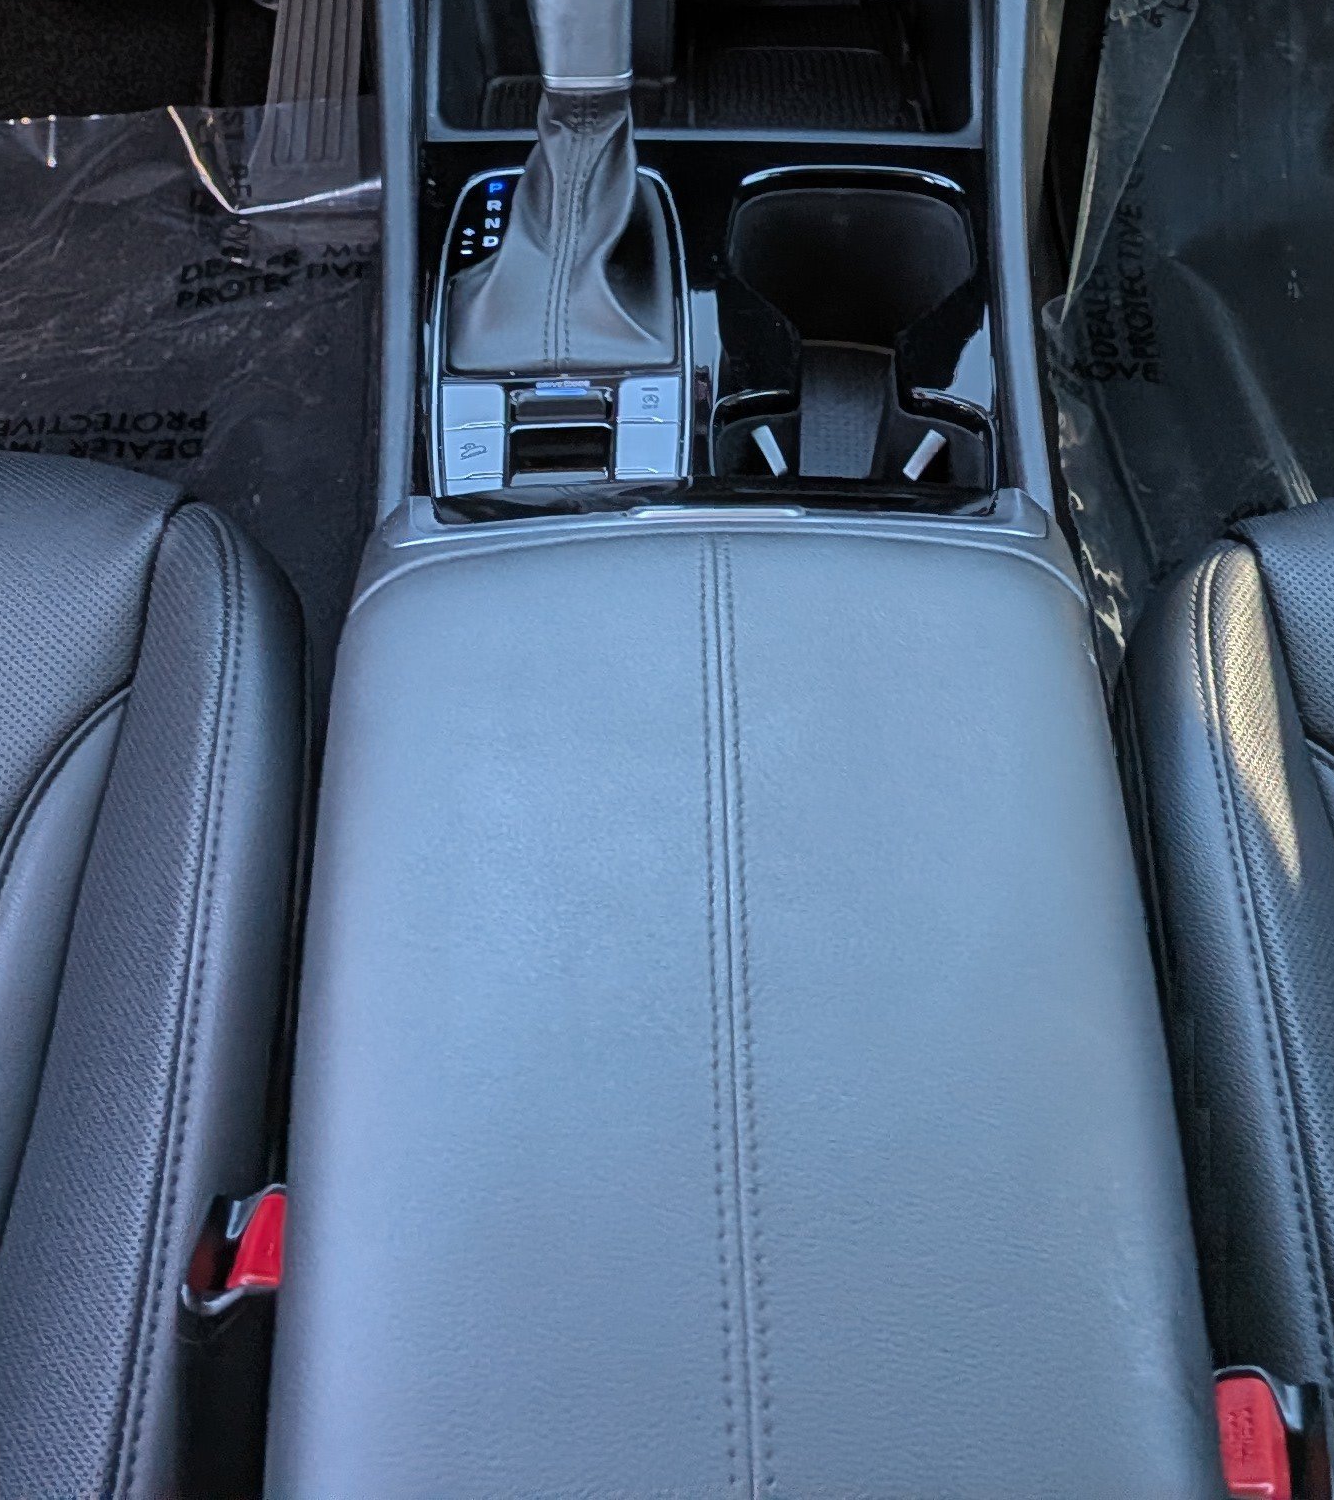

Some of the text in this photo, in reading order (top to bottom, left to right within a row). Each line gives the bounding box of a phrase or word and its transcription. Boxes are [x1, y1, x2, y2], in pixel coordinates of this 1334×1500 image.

[488, 182, 504, 194] P
[486, 200, 503, 212] R
[484, 217, 501, 230] N
[482, 235, 499, 248] D
